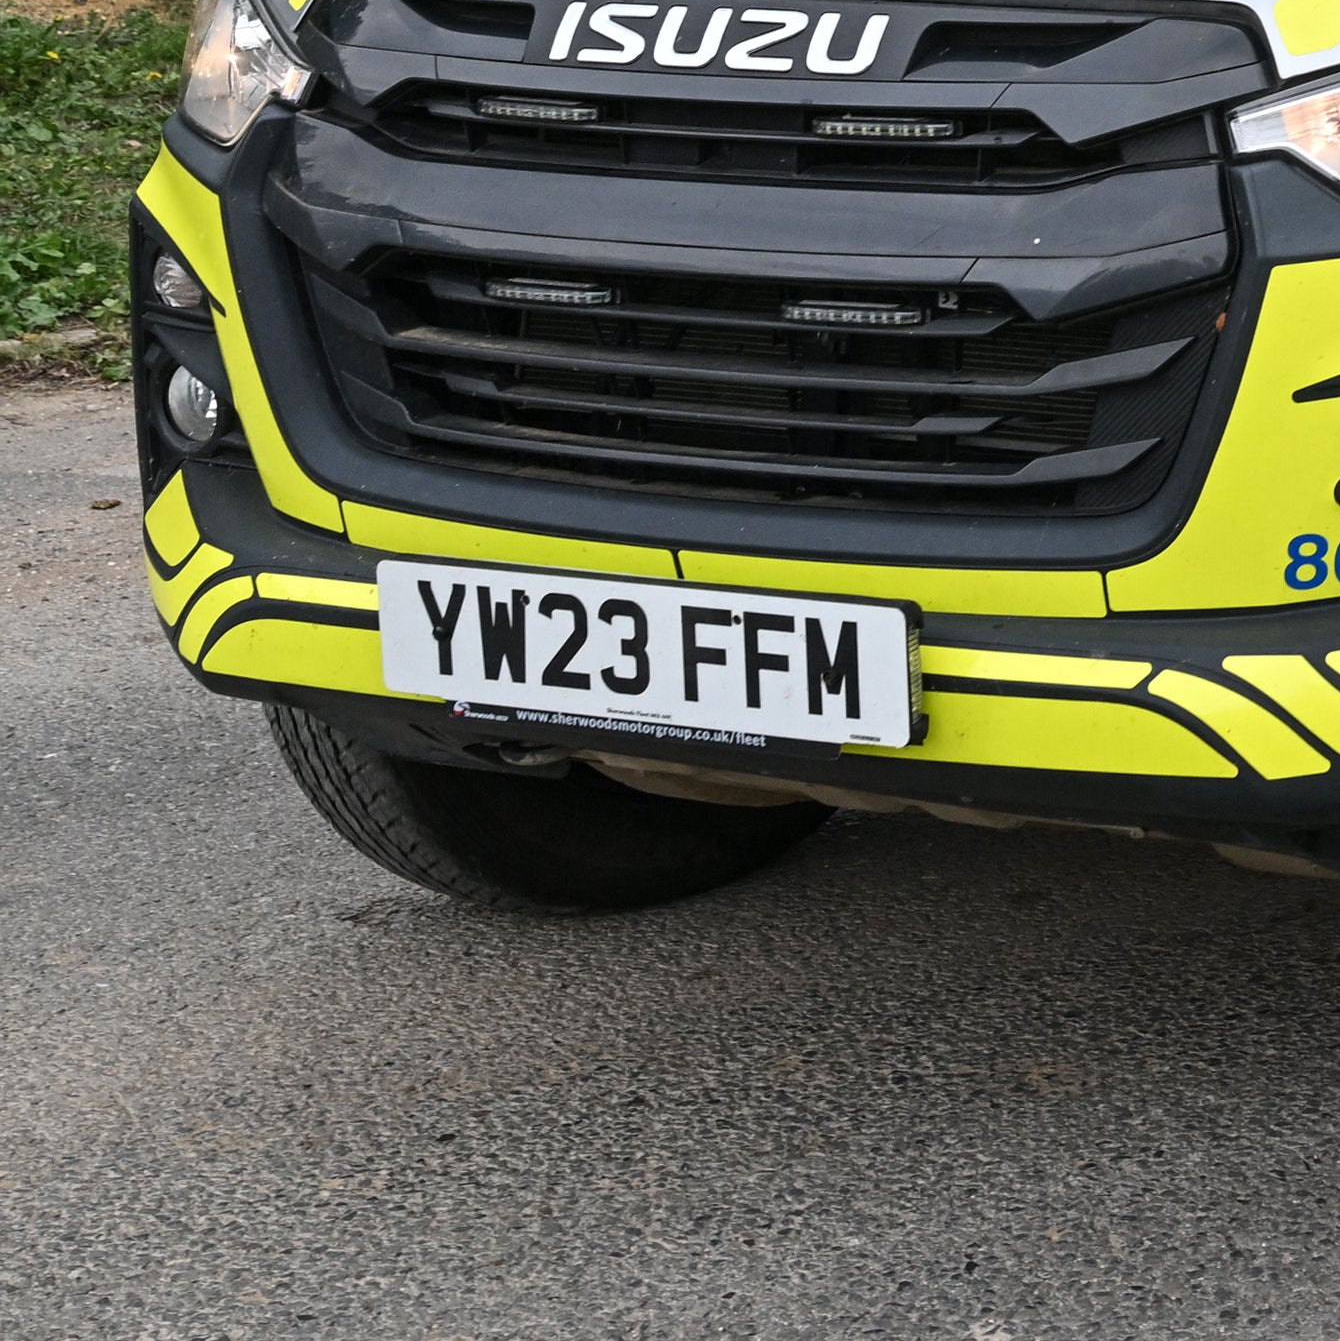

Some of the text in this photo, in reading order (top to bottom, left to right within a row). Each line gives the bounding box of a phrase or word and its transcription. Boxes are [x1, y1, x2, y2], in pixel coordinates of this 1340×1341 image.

[547, 1, 890, 75] ISUZU
[416, 579, 862, 720] YW23 FFM
[515, 708, 767, 748] www.sherwoodsmotorgroup.co.uk/fleet
